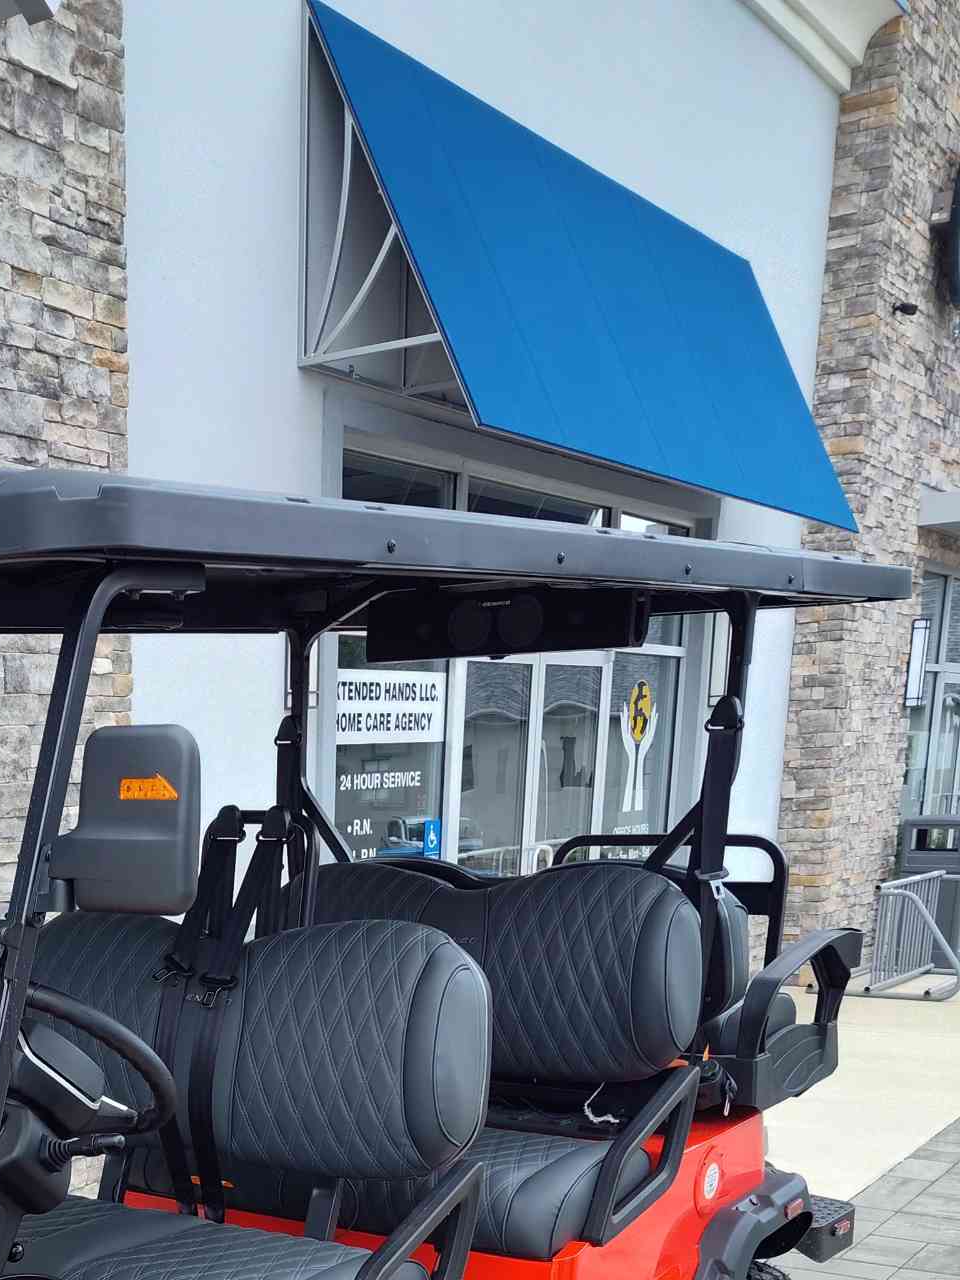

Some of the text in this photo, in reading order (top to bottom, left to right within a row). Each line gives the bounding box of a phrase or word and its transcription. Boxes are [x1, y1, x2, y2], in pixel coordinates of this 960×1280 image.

[384, 682, 417, 702] HANDS
[365, 712, 392, 732] CARE
[394, 712, 433, 731] AGENCY
[339, 771, 422, 791] 24 HOUR SERVICE
